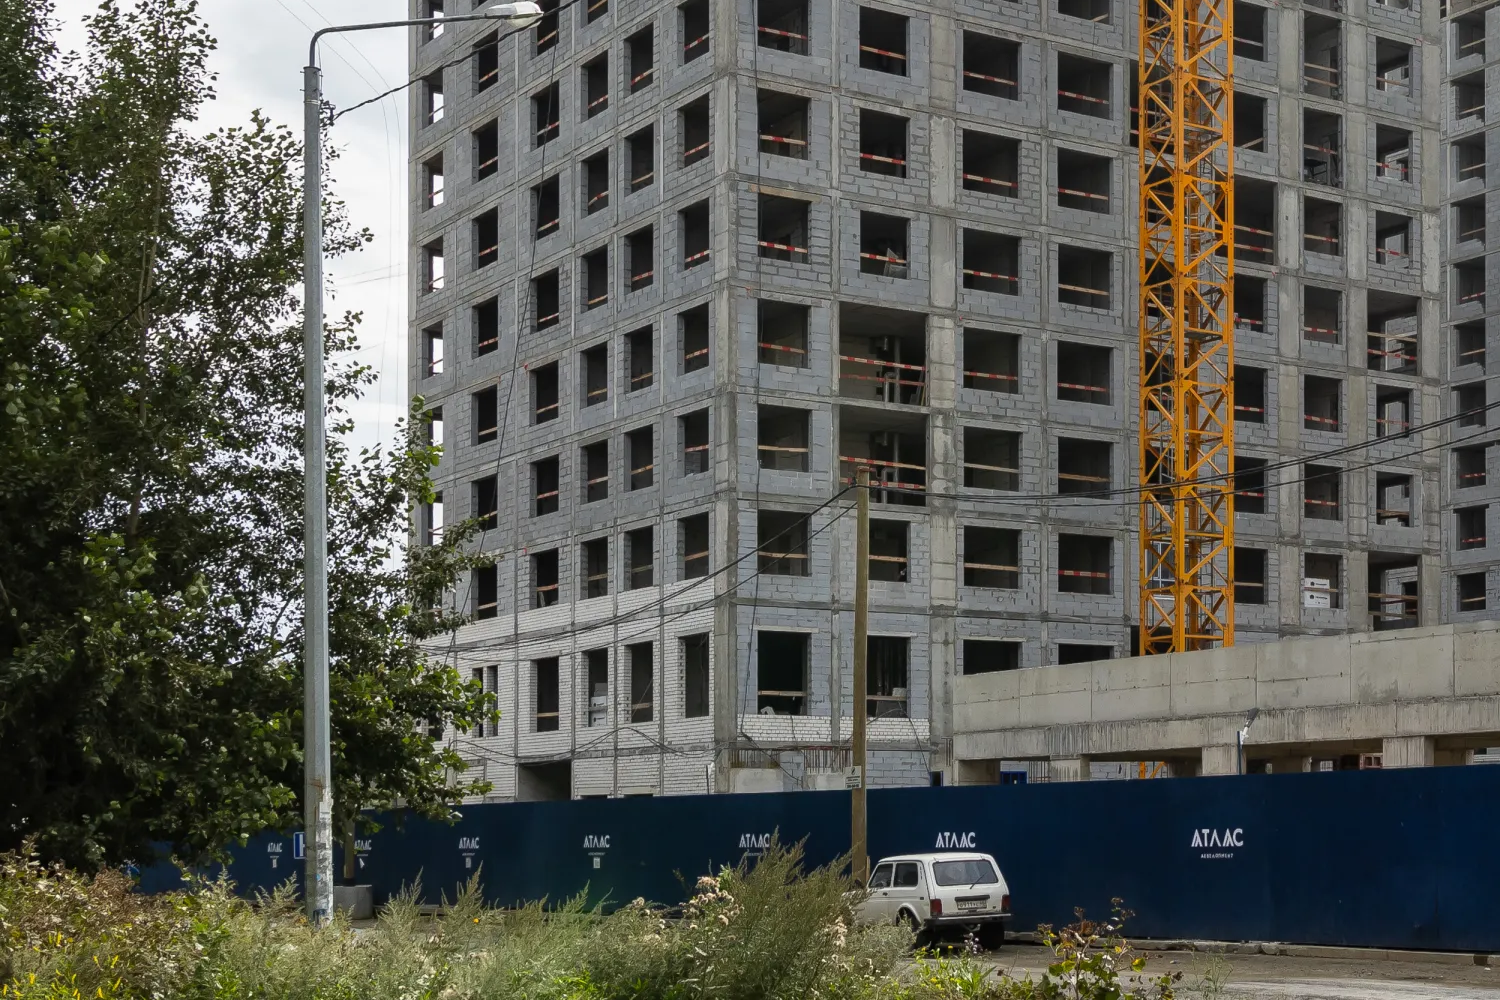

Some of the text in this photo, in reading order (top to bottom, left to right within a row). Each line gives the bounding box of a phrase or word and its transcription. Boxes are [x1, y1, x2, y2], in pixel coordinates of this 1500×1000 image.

[583, 835, 610, 848] АТЛАС
[935, 832, 976, 848] АТЛАС
[1191, 828, 1244, 847] АТЛАС
